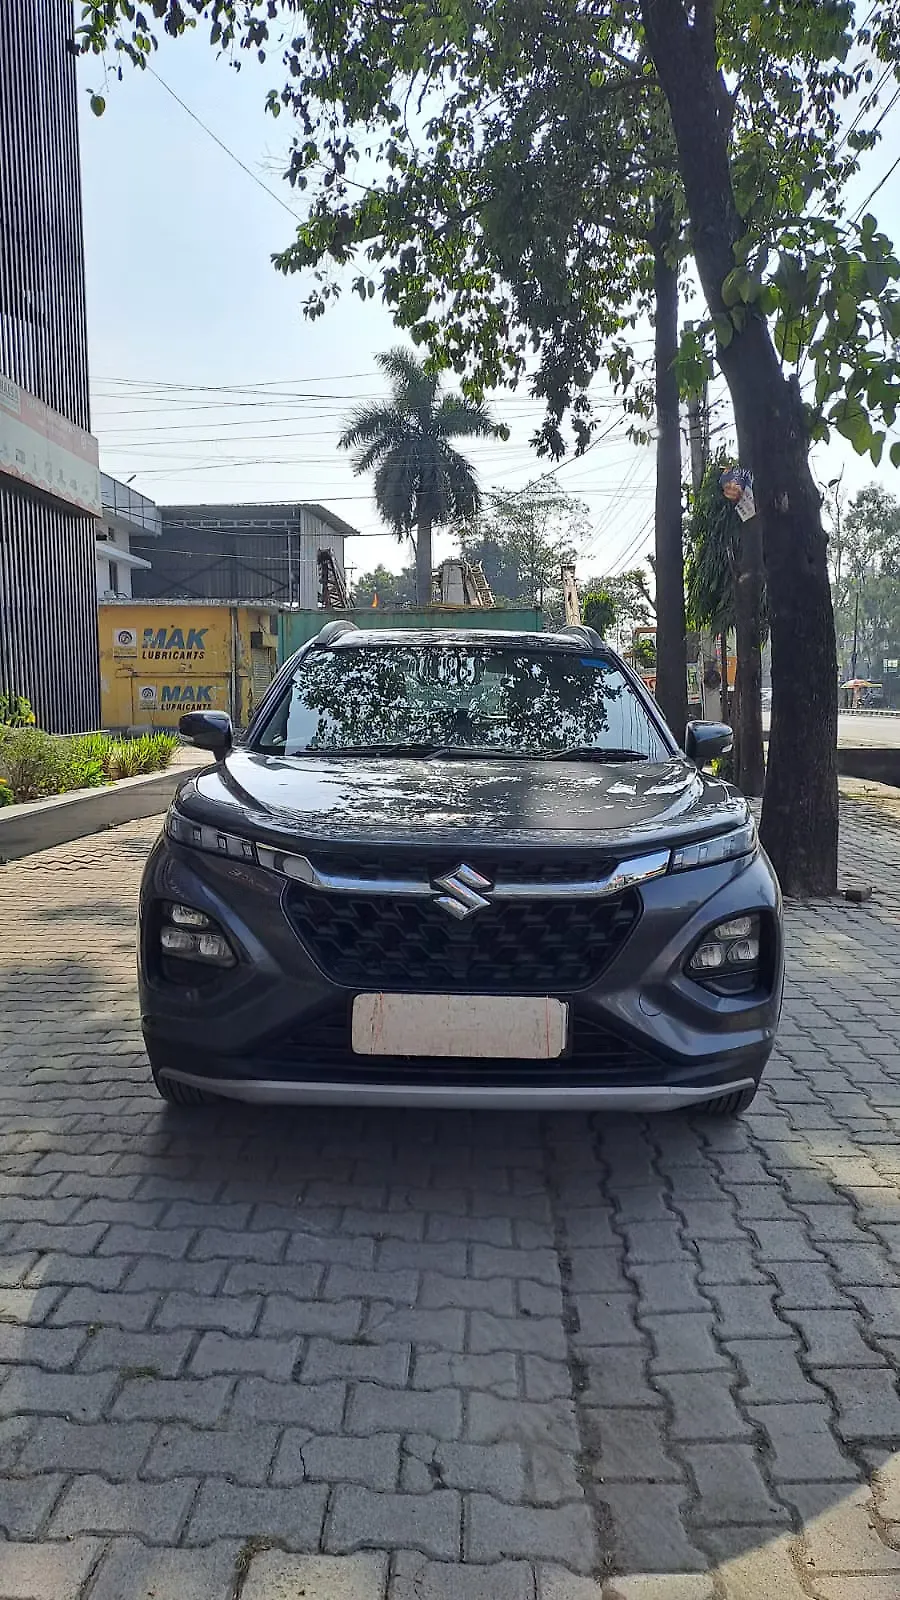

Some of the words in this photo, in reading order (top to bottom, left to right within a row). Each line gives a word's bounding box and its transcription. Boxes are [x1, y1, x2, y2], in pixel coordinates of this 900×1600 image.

[142, 628, 209, 649] MAK
[142, 651, 205, 660] LUBRICANTS
[161, 685, 215, 702] MAK
[161, 703, 212, 711] LUBRICANTS
